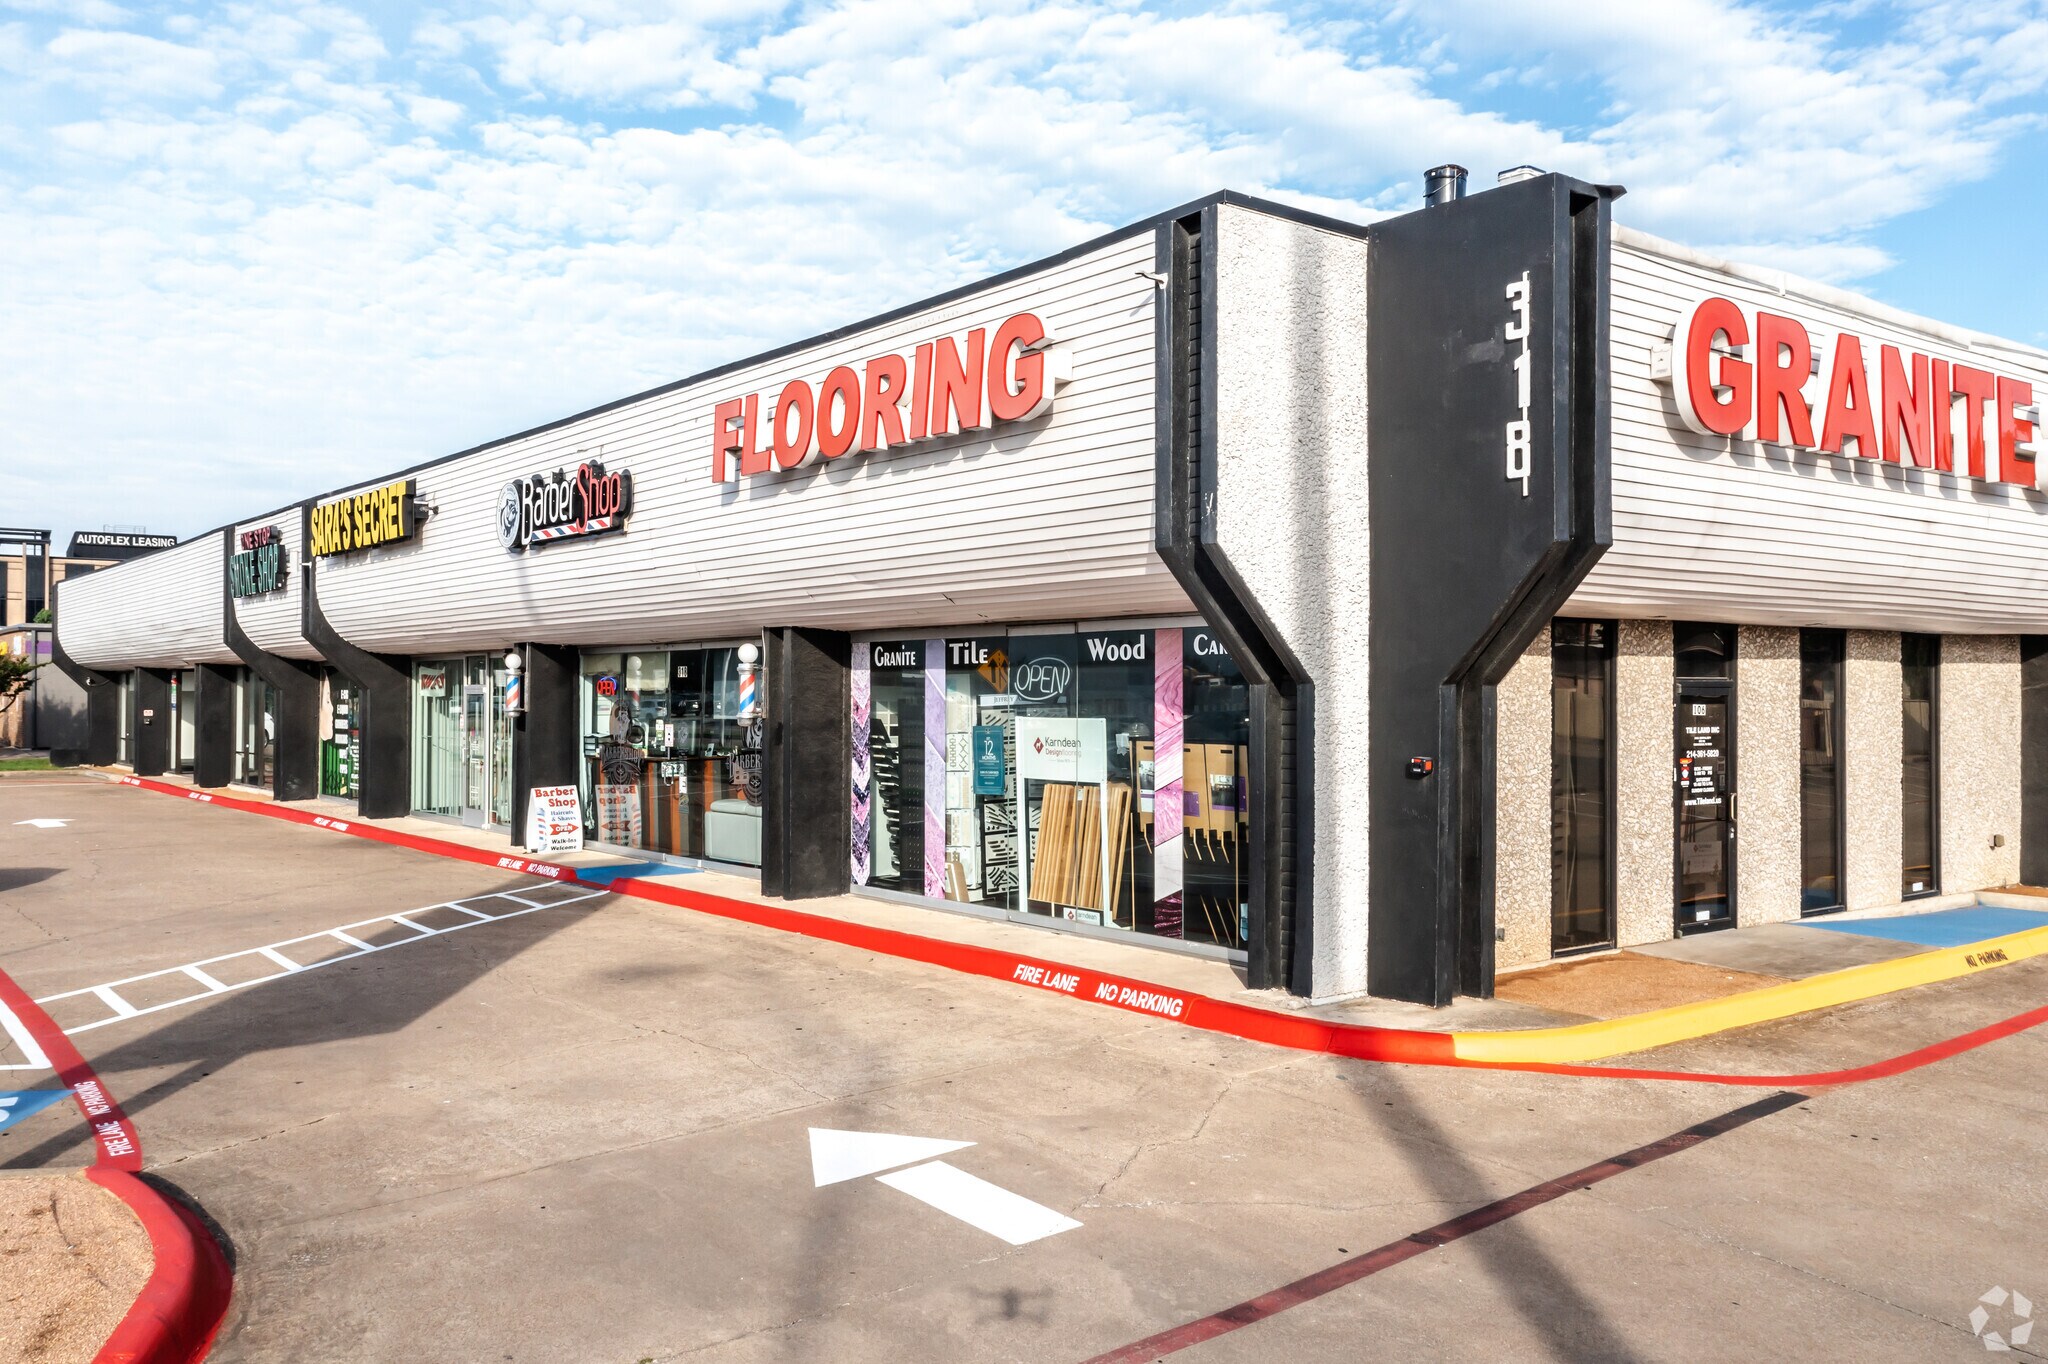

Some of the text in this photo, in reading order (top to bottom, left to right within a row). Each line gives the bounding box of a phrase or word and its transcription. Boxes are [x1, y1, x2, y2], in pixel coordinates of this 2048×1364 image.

[712, 312, 1046, 484] FLOORING
[1505, 271, 1531, 497] 318
[1686, 297, 2036, 488] GRANITE
[521, 471, 577, 545] Barber
[575, 463, 621, 534] Shop
[310, 480, 407, 557] SARA'S SECRET
[76, 533, 175, 548] AUTOFLEX LEASING
[254, 526, 270, 549] STOP
[257, 543, 279, 593] SHOP
[1086, 634, 1146, 662] Wood
[596, 679, 616, 696] OPEN
[1016, 663, 1066, 694] OPEN
[983, 740, 995, 756] 12
[1044, 736, 1082, 748] Karndean
[534, 787, 575, 798] Barber
[548, 798, 577, 807] Shop
[535, 865, 560, 878] PARKING
[1964, 948, 2009, 968] NO PARKING
[1013, 963, 1081, 992] FIRE LANE
[1094, 982, 1184, 1017] NO PARKING
